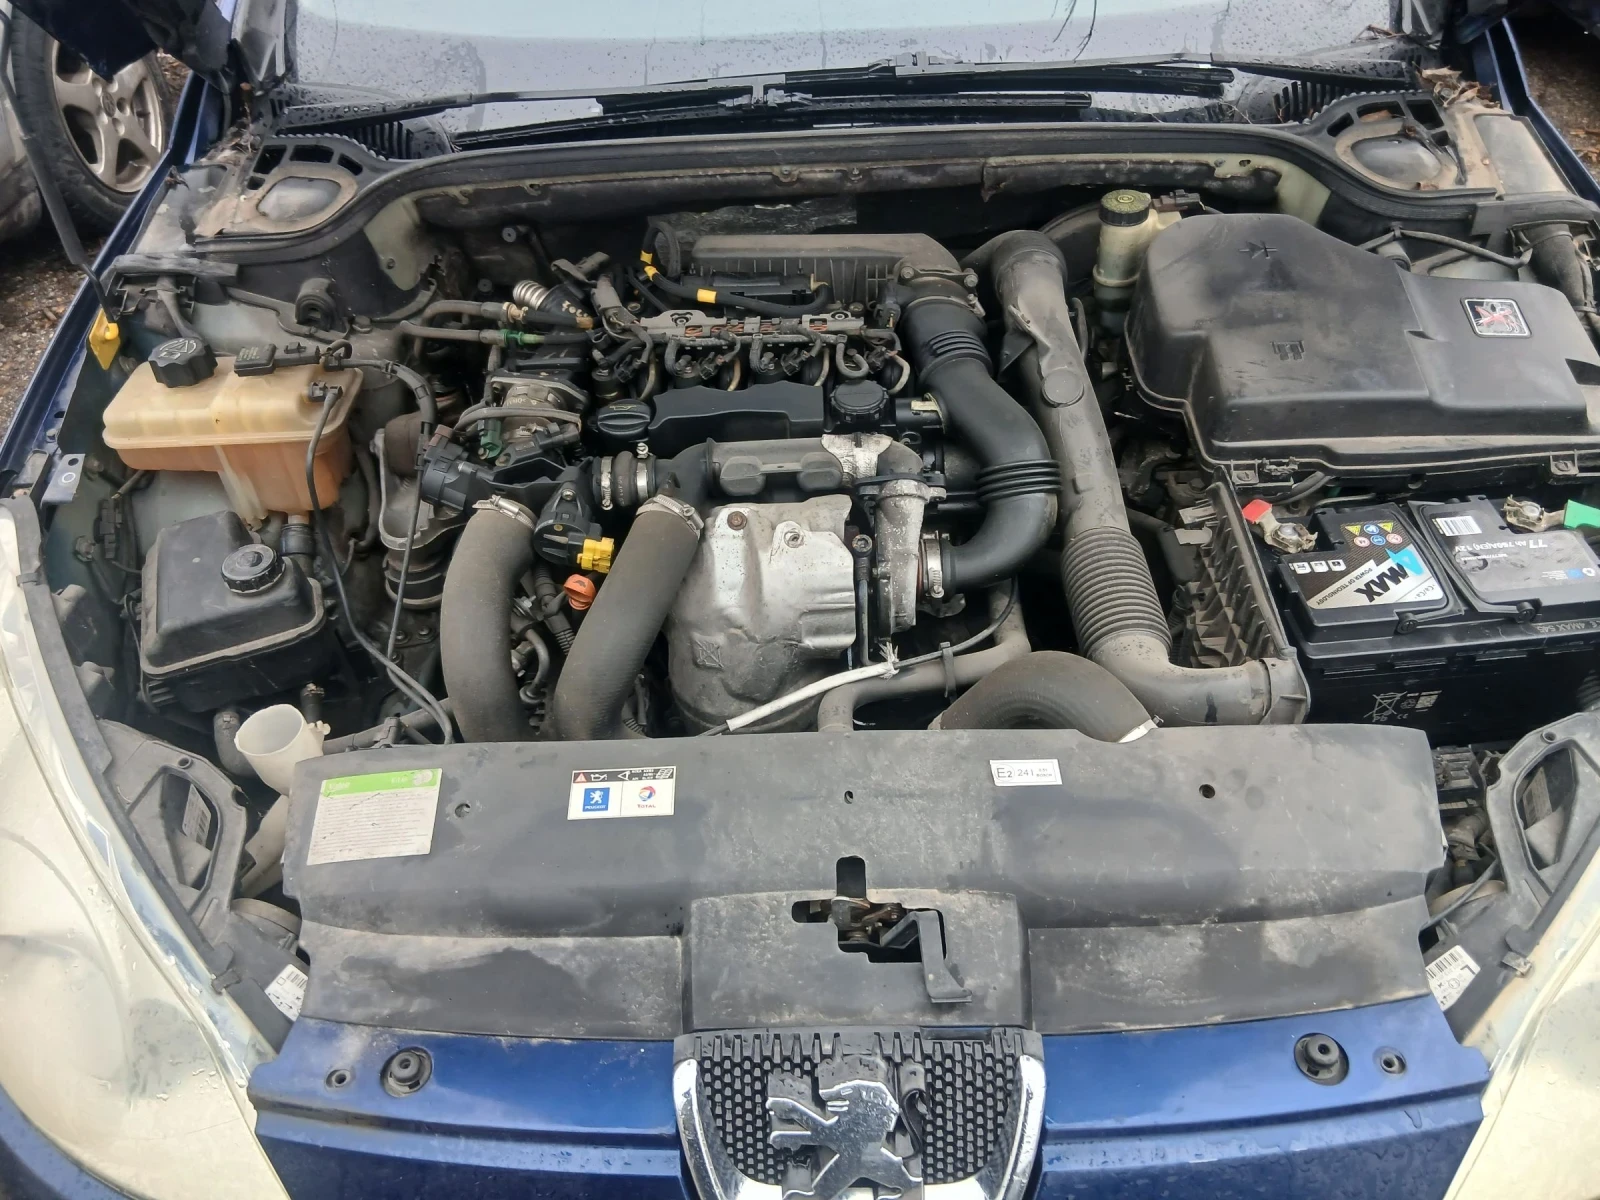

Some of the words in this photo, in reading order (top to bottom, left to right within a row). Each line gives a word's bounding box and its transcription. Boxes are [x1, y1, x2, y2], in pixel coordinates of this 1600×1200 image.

[1529, 539, 1548, 549] 77
[1354, 567, 1373, 581] POWER
[1316, 583, 1349, 606] TECHNOLOGY
